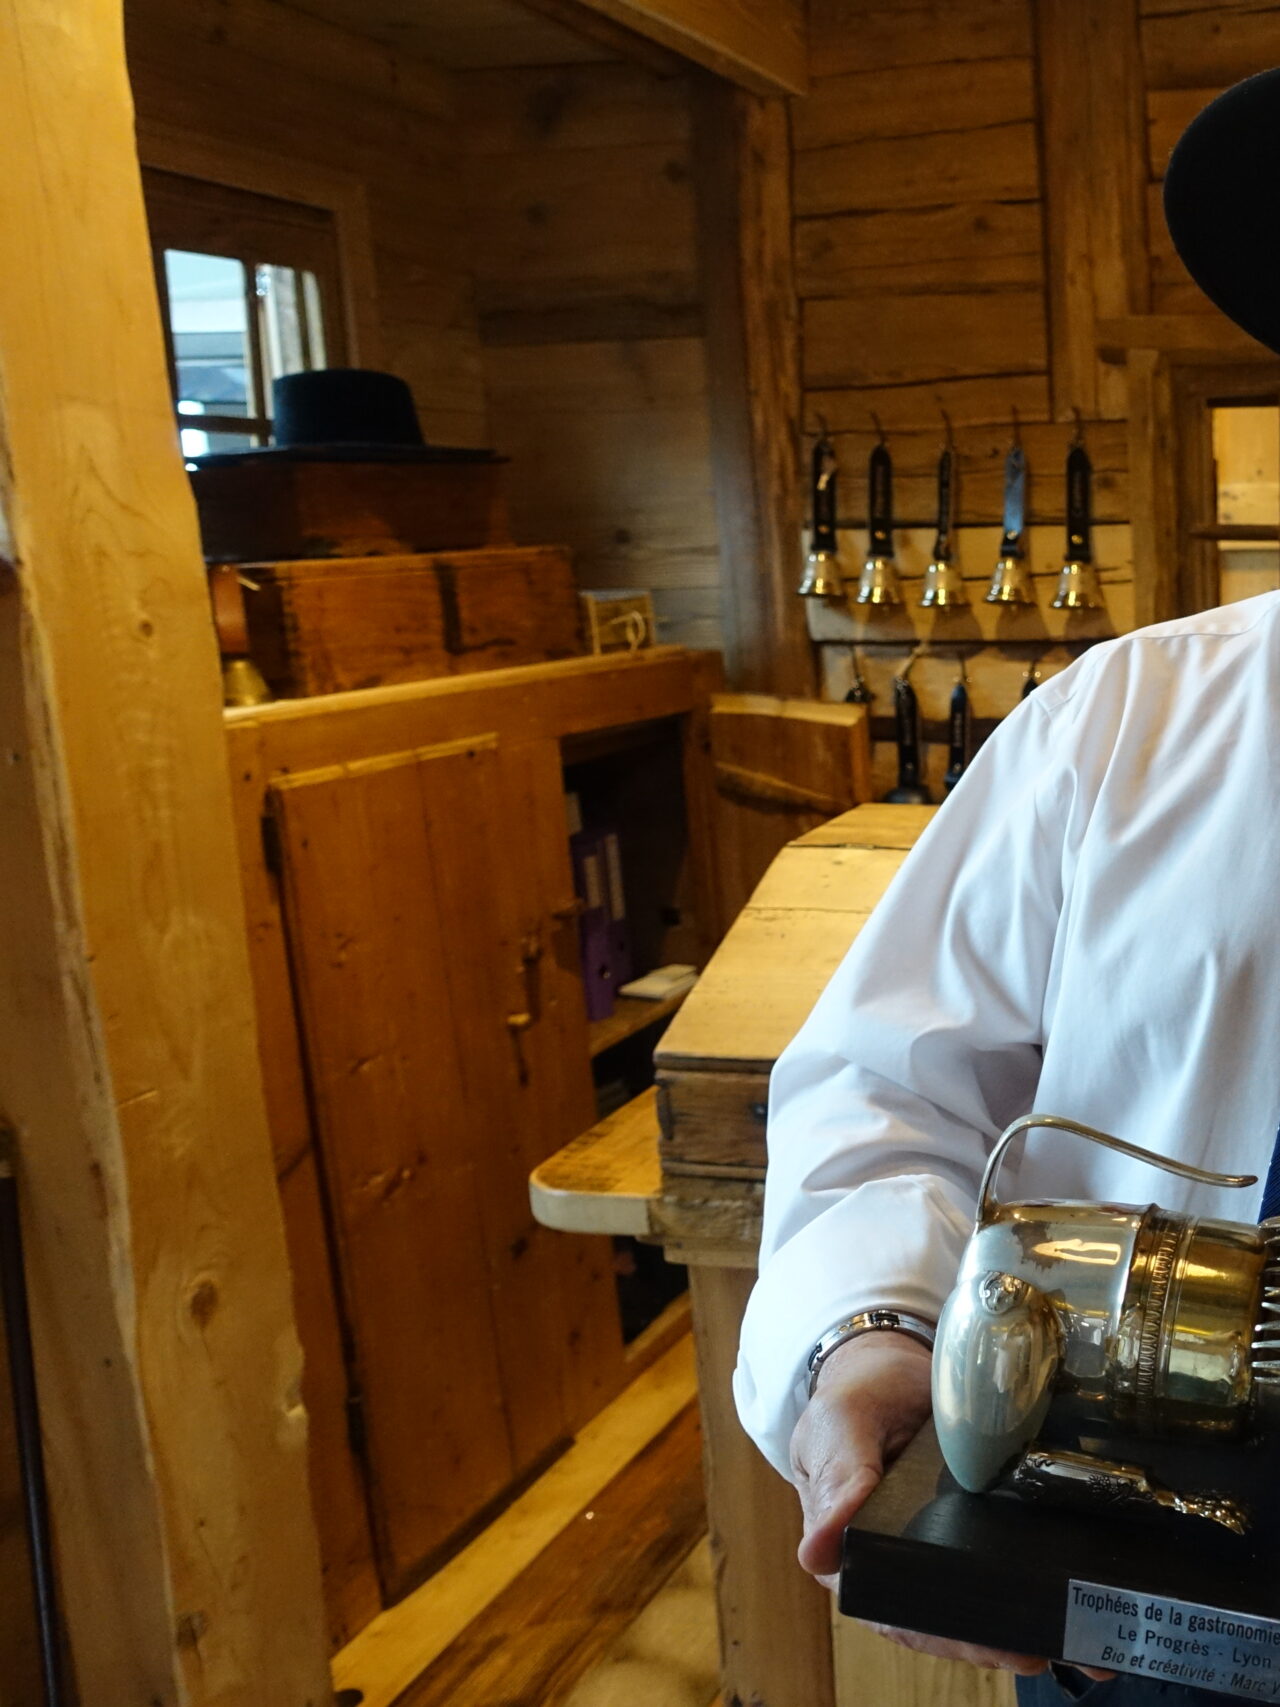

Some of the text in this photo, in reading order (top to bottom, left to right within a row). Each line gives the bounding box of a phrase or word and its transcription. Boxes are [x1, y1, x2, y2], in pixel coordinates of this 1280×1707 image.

[1073, 1587, 1138, 1617] Trophées
[1145, 1602, 1163, 1622] de
[1169, 1606, 1182, 1626] la
[1118, 1624, 1137, 1641] Le
[1145, 1630, 1209, 1657] Progrès
[1232, 1647, 1272, 1668] Lyon
[1101, 1646, 1125, 1664] Bio
[1130, 1654, 1145, 1668] et
[1148, 1659, 1216, 1682] créativité
[1230, 1673, 1266, 1692] Marc
